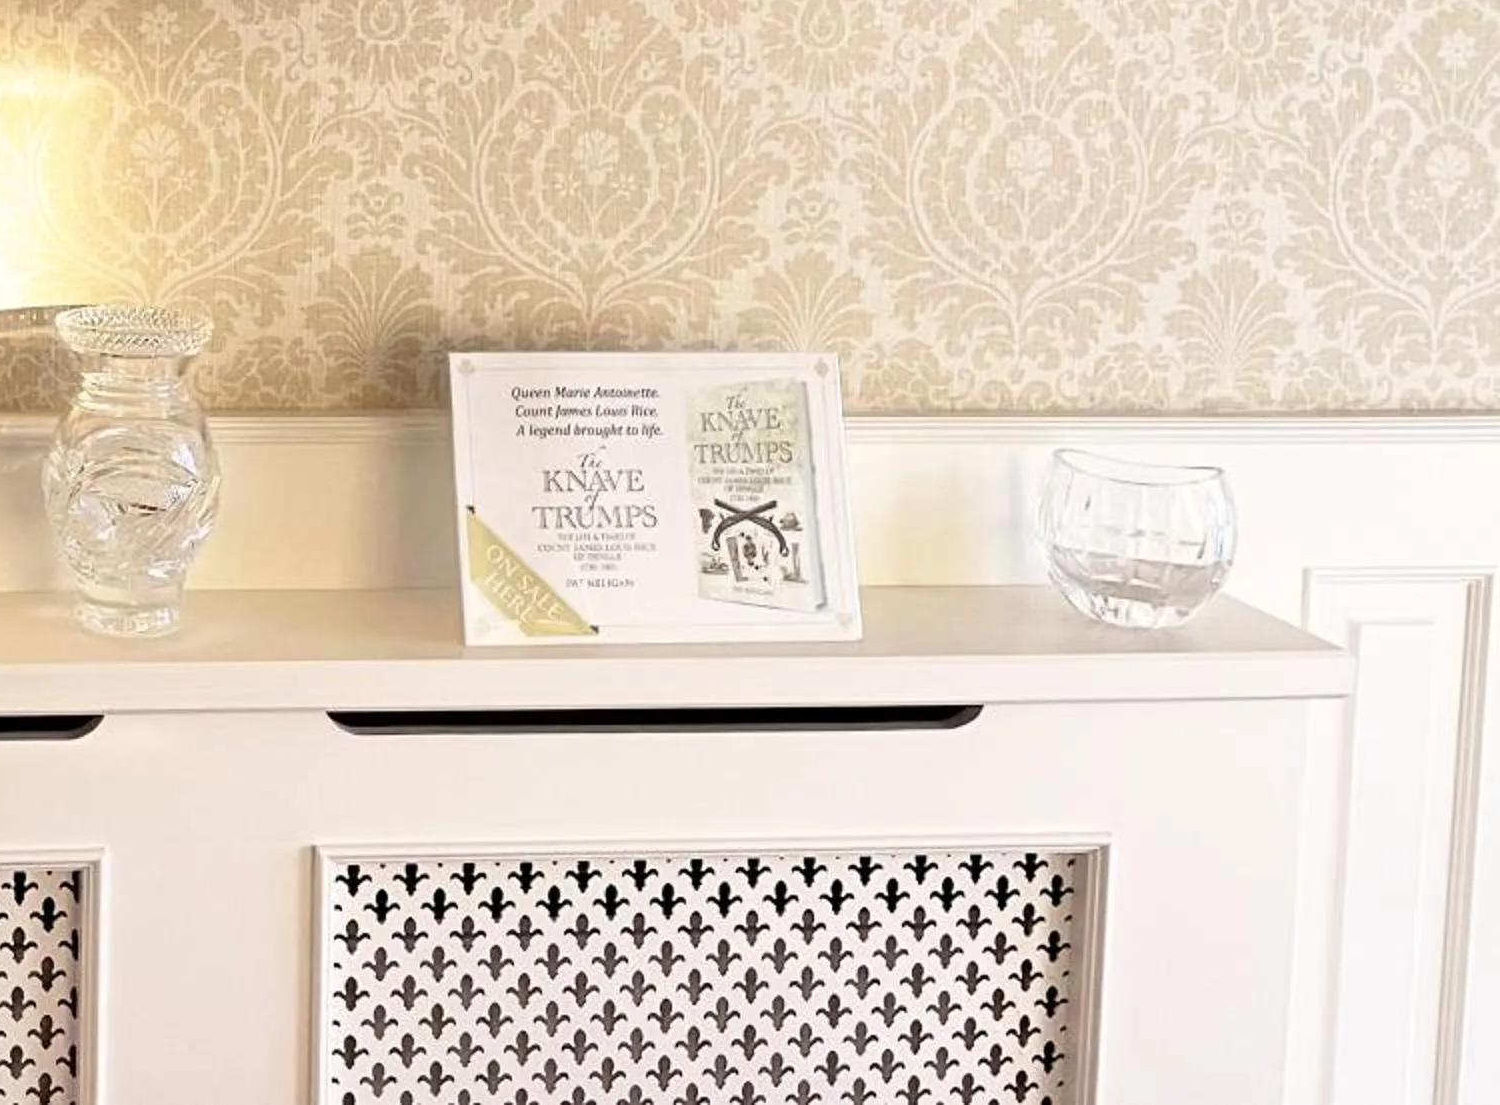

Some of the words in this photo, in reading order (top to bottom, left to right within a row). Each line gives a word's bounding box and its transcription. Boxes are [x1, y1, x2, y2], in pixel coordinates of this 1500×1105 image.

[511, 386, 550, 401] Queen
[554, 386, 590, 398] Marie
[593, 386, 660, 399] Antoinette.
[515, 404, 553, 418] Count
[555, 404, 592, 419] James
[595, 404, 627, 417] Louis
[699, 406, 781, 432] KNAVE
[515, 424, 525, 437] A
[529, 424, 571, 439] legend
[573, 423, 623, 439] brought
[626, 424, 639, 436] to
[641, 422, 664, 439] life.
[693, 440, 793, 464] TRUMPS
[541, 467, 645, 493] KNAVE
[531, 504, 658, 529] TRUMPS
[486, 544, 518, 578] ON
[517, 575, 564, 620] SALE
